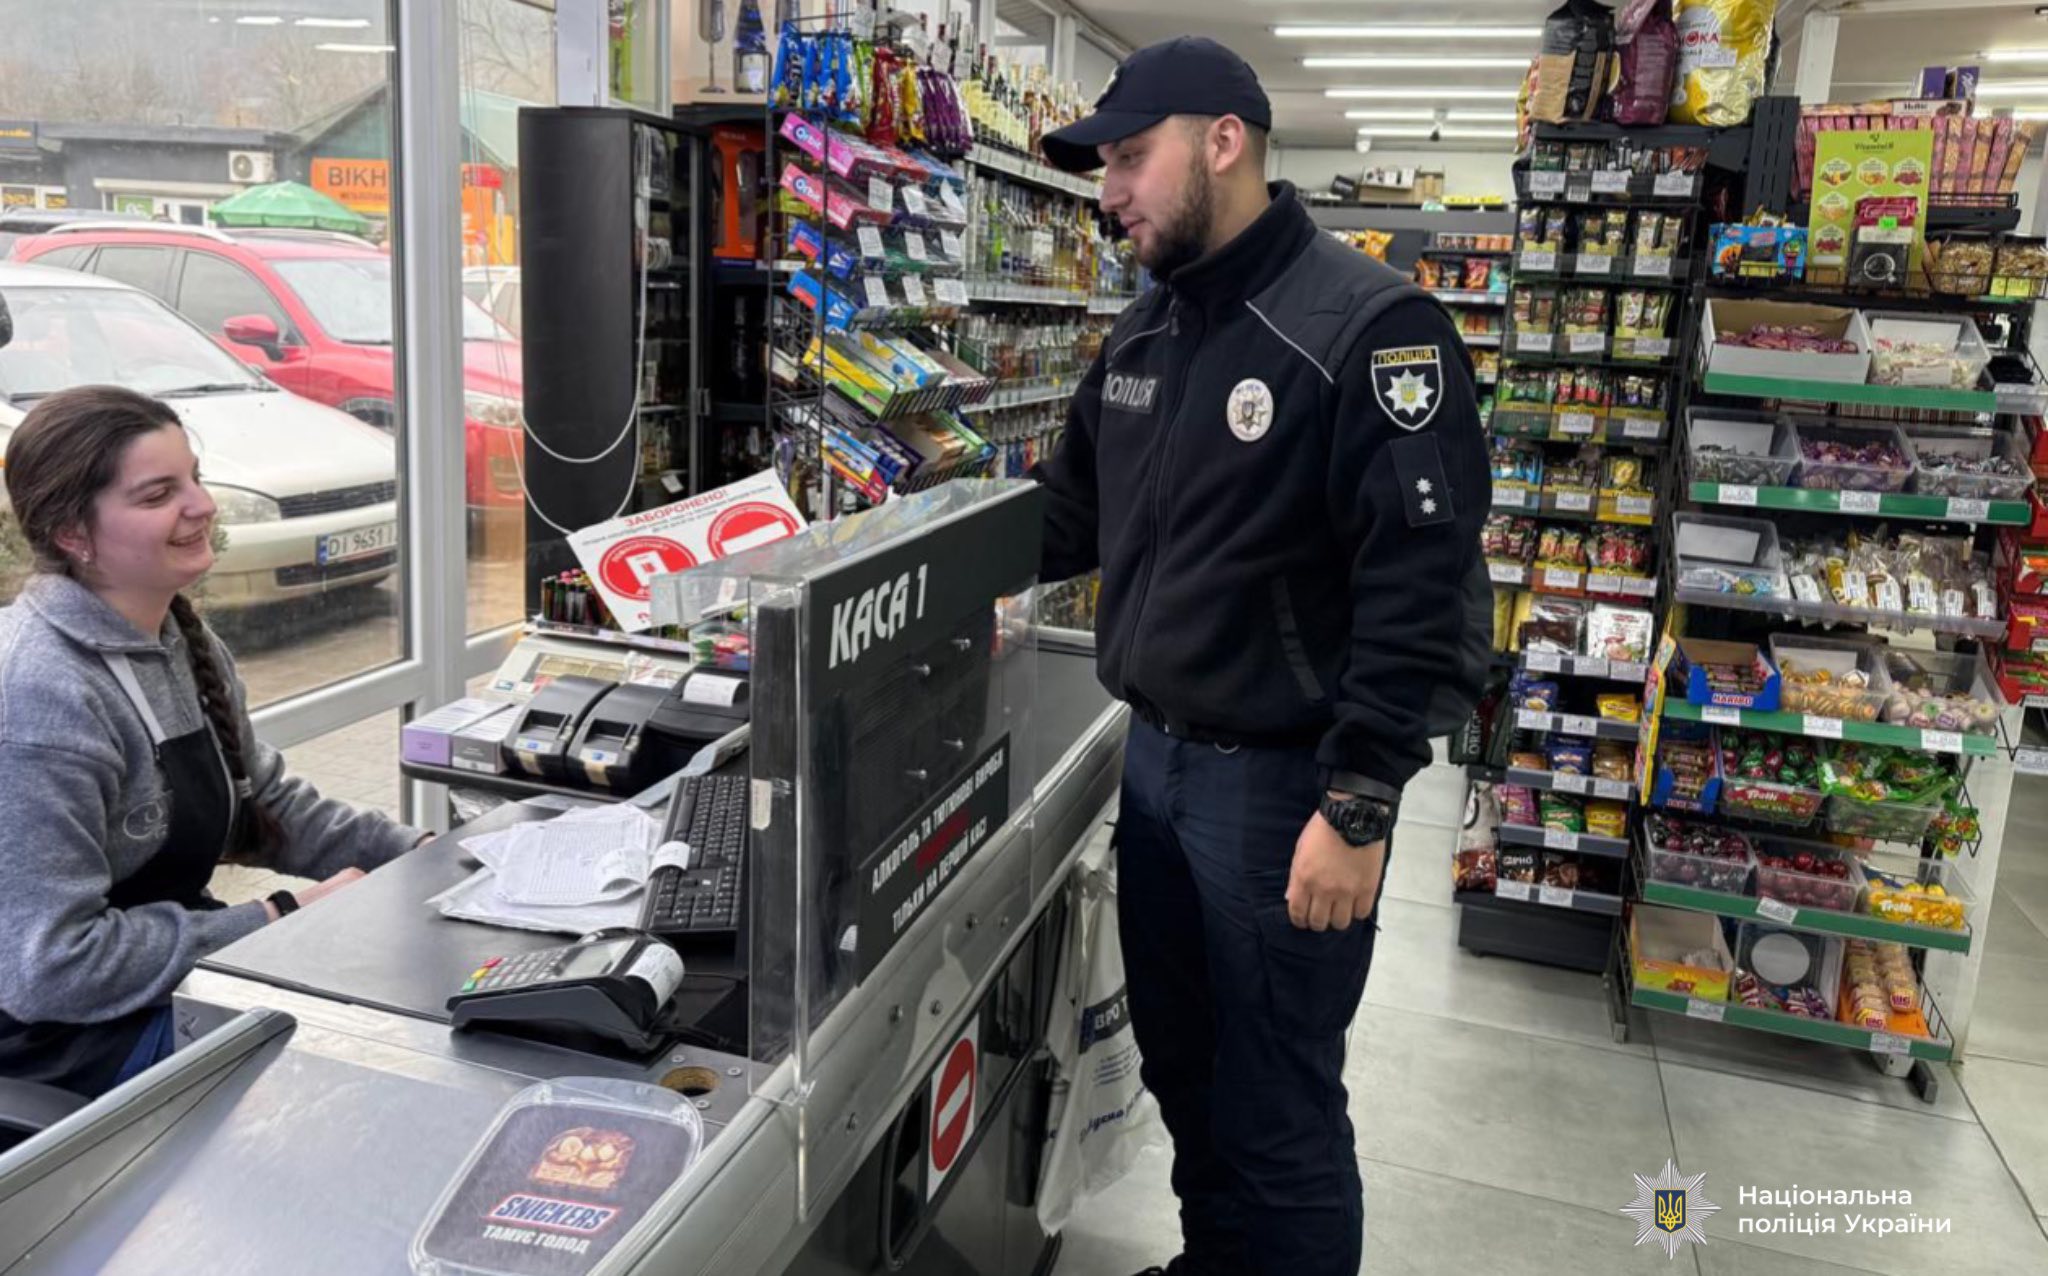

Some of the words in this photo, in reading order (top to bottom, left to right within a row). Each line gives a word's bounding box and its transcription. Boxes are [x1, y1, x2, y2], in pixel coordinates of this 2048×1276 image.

[328, 166, 387, 188] ВІКН
[1377, 348, 1432, 365] ПОЛІЦІЯ
[624, 489, 727, 527] ЗАБОРОНЕНО!
[828, 571, 910, 670] КАСА
[916, 563, 928, 619] 1
[495, 1196, 610, 1230] SNICKERS
[482, 1225, 536, 1244] ТАМУЄ
[533, 1231, 592, 1255] ГОЛОД
